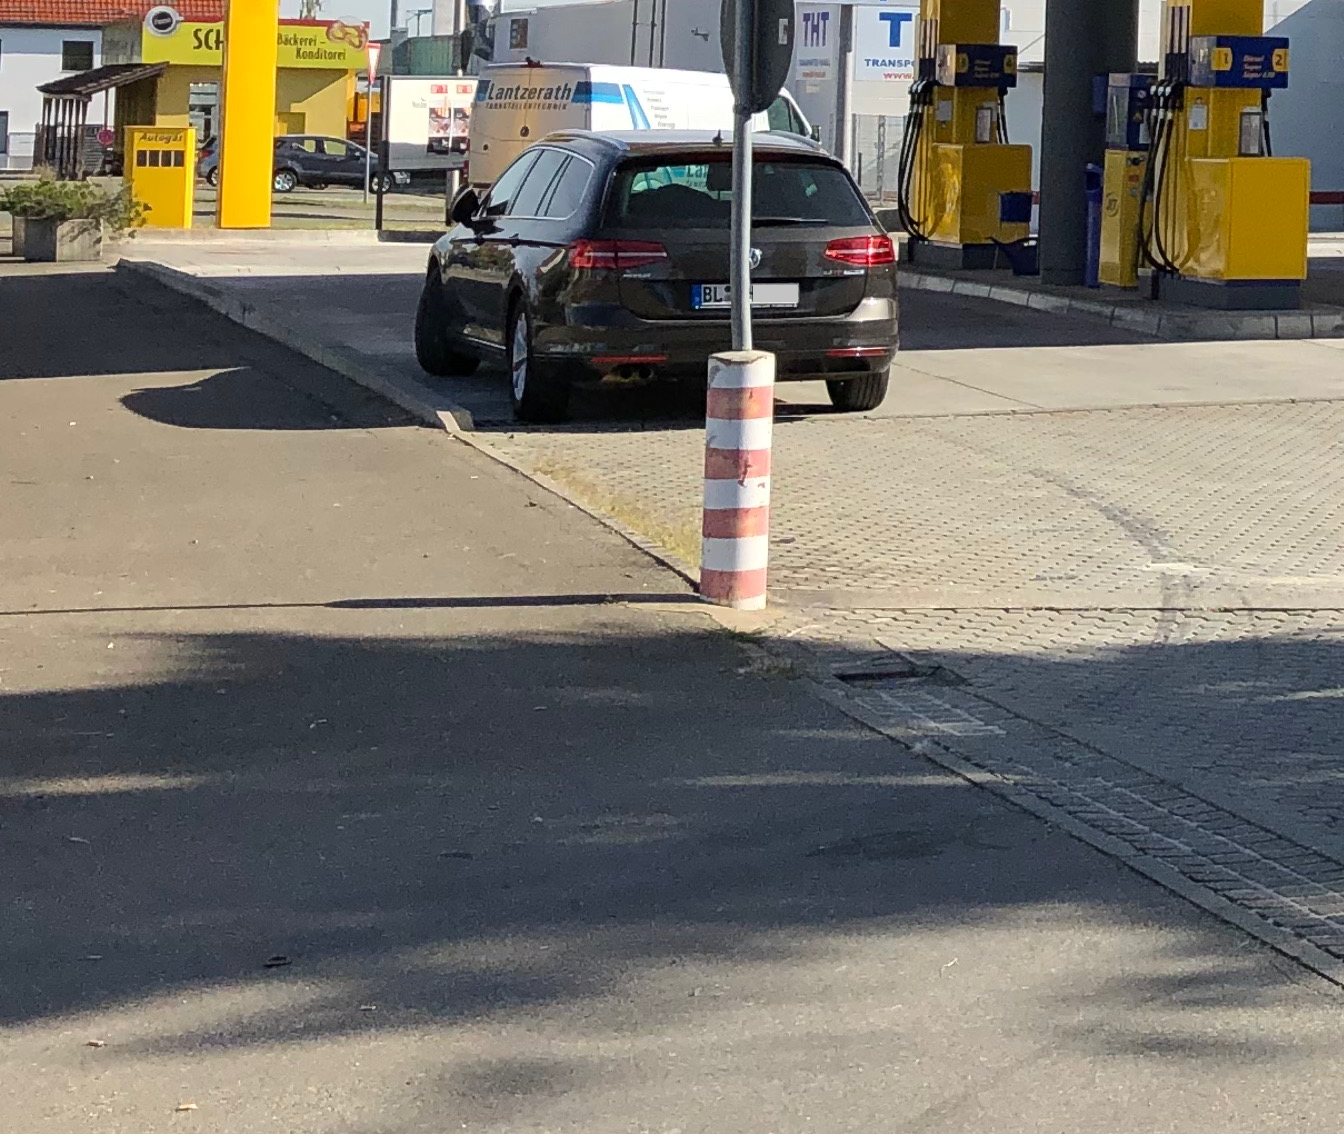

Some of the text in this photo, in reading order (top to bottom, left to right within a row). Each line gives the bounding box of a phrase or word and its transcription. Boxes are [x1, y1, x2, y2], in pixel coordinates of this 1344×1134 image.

[803, 12, 829, 47] THT
[295, 48, 346, 60] Konditorei
[1275, 54, 1283, 66] 2
[488, 82, 572, 101] Lantzerath
[703, 286, 723, 303] BL
